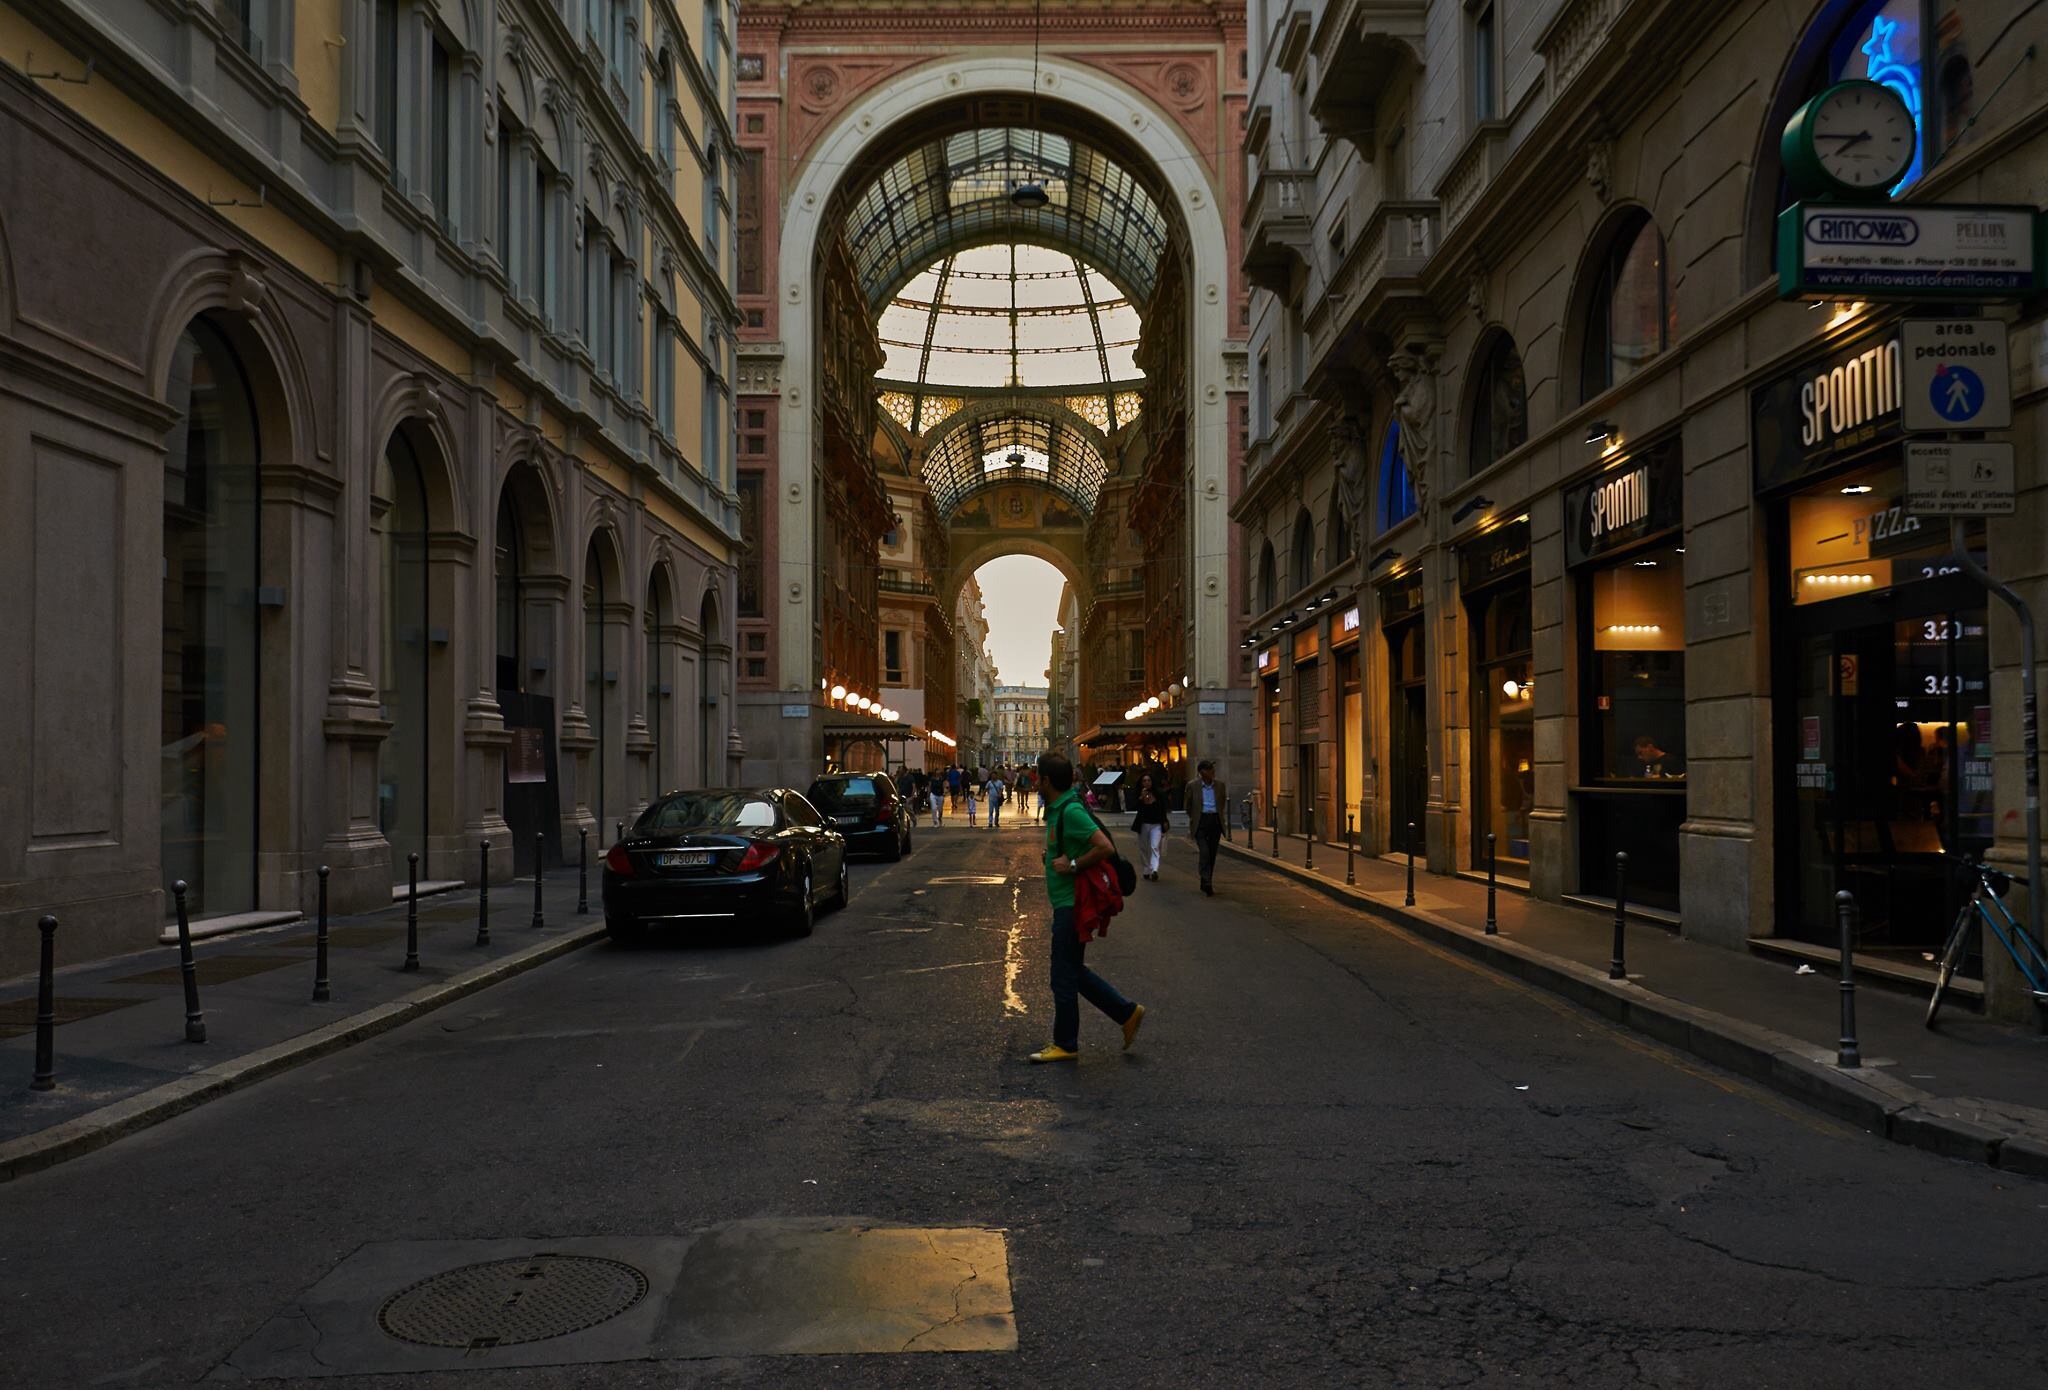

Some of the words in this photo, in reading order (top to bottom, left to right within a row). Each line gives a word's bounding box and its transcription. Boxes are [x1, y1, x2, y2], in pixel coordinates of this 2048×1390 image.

[1820, 219, 1907, 241] RIMOWA
[1837, 256, 1871, 266] Agnello
[1880, 257, 1904, 266] Milan
[1915, 258, 1945, 267] Phone
[1818, 272, 2018, 288] www.rimowastoremilano.it
[1936, 324, 1974, 335] area
[1915, 342, 1996, 360] pedonale
[1590, 465, 1649, 538] SPONTINI
[1853, 506, 1921, 545] PIZZA
[663, 854, 675, 865] DP
